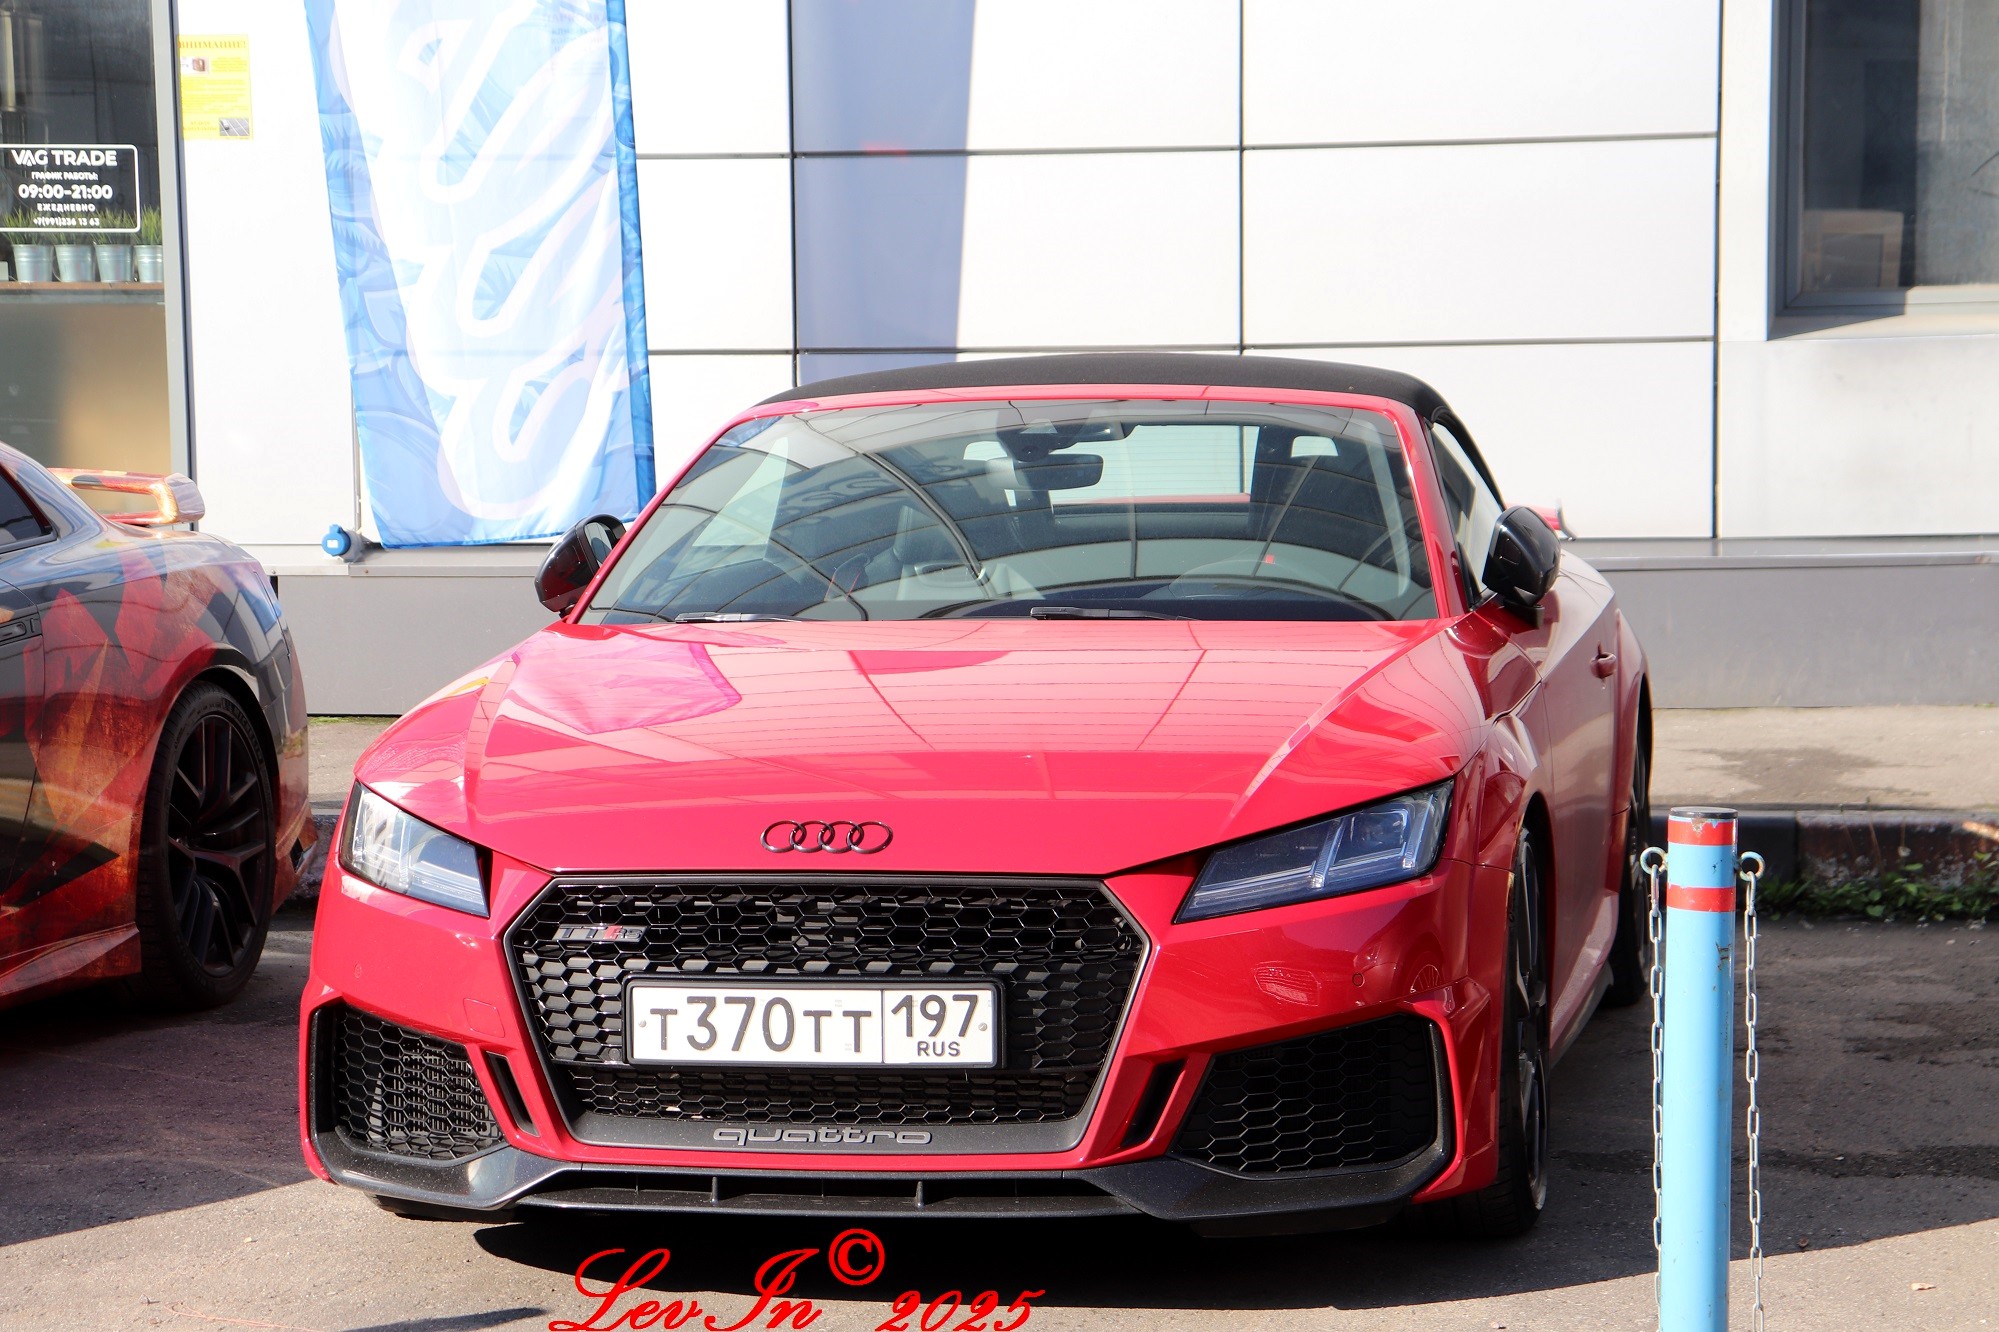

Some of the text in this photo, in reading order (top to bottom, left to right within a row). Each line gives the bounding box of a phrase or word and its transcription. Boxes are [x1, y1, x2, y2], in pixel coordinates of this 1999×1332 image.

[11, 149, 118, 167] VAG TRADE
[31, 171, 62, 180] ГРАФИК
[37, 203, 96, 213] ЕЖЕДНЕВНО
[890, 994, 979, 1038] 197
[917, 1040, 961, 1058] RUS
[713, 1126, 932, 1146] quattro
